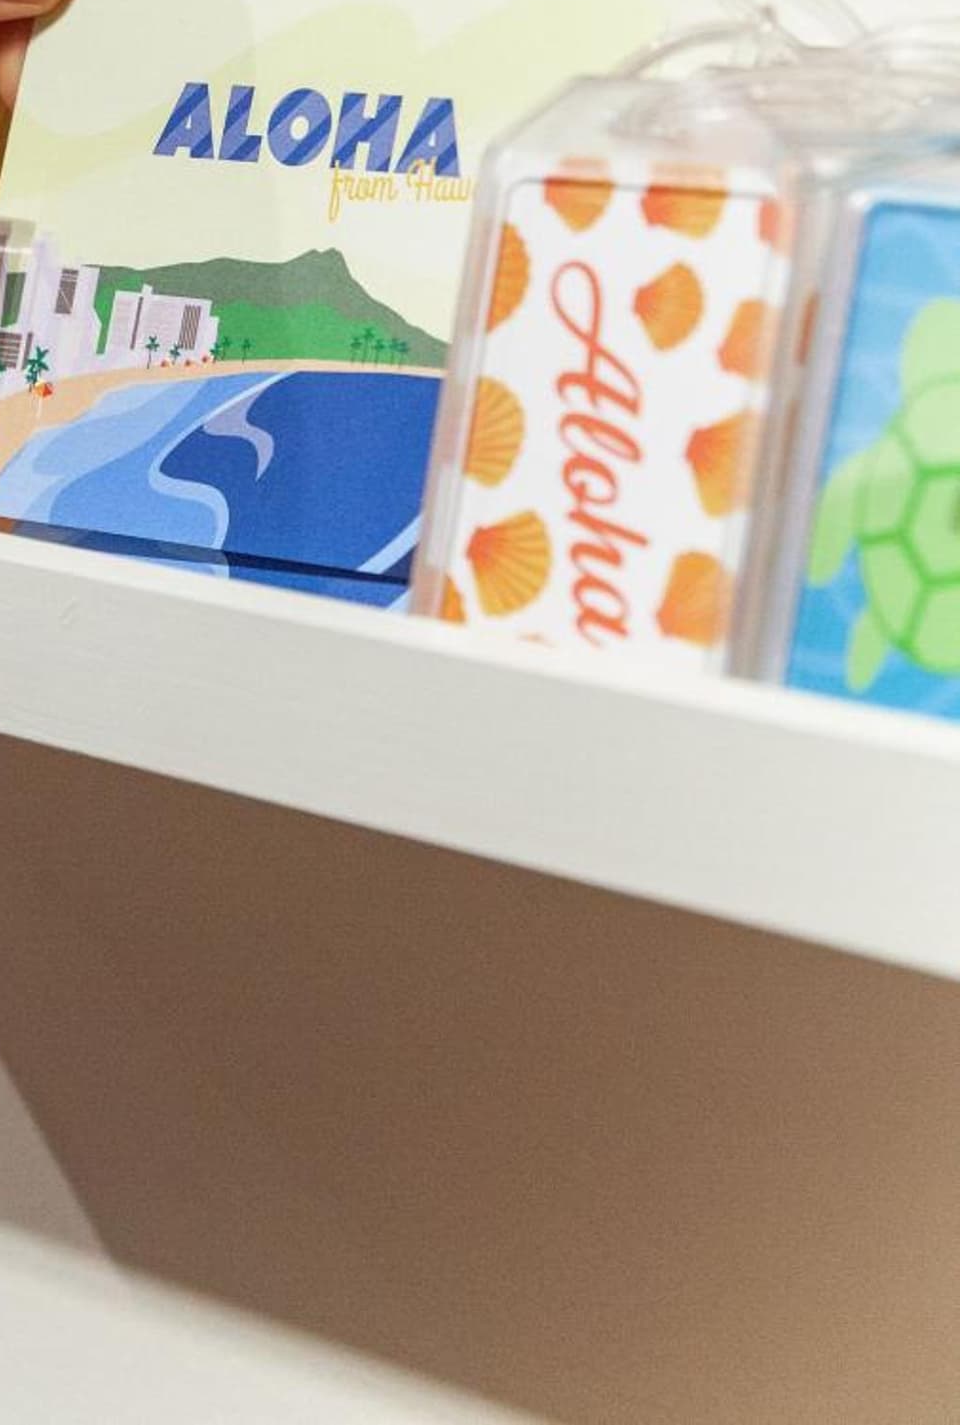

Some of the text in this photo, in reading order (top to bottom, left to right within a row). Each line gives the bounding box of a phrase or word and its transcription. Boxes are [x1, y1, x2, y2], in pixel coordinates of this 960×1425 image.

[152, 80, 461, 177] ALOHA
[329, 166, 400, 222] from
[551, 259, 650, 649] Aloha
